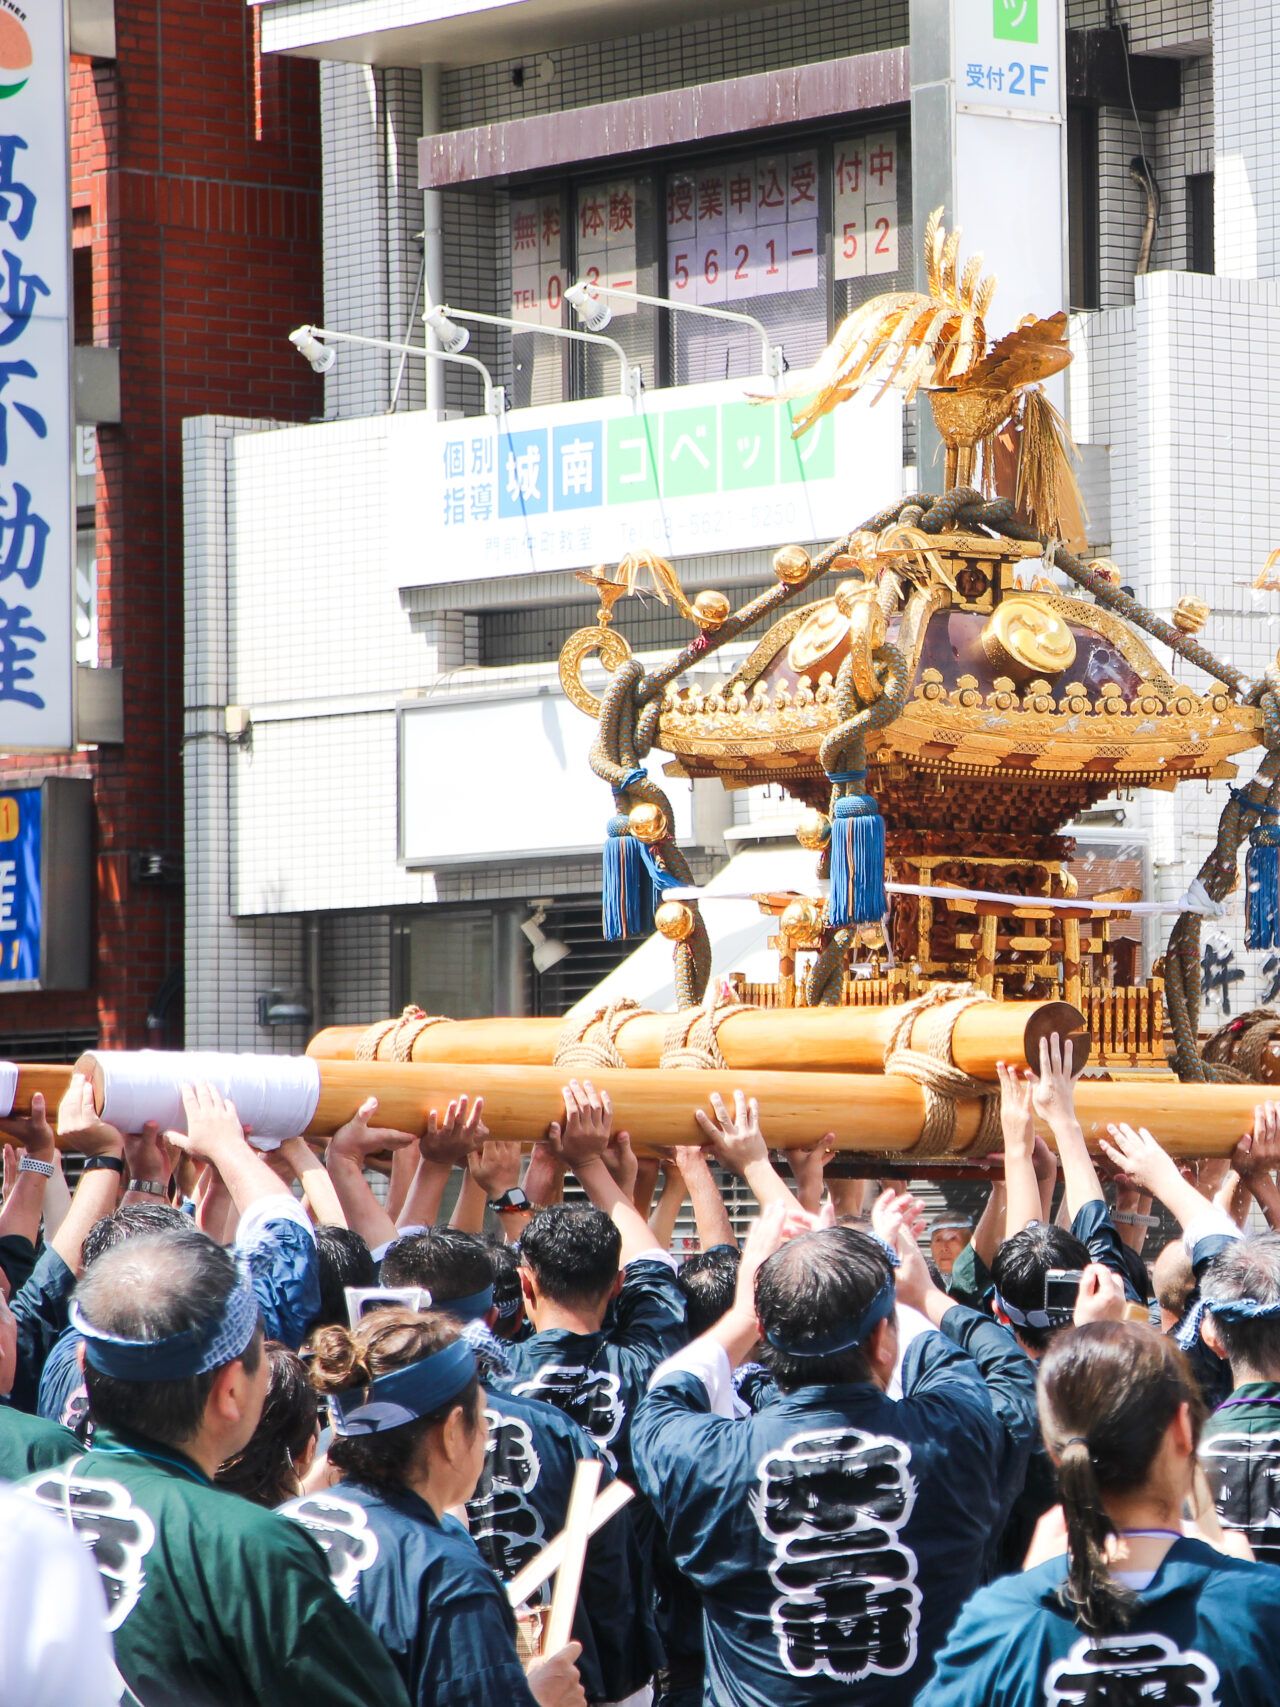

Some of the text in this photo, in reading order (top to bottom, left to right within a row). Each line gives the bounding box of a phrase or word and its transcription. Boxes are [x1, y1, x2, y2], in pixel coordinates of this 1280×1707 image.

[513, 290, 538, 310] TEL
[443, 436, 493, 480] 個別
[443, 482, 493, 526] 指導
